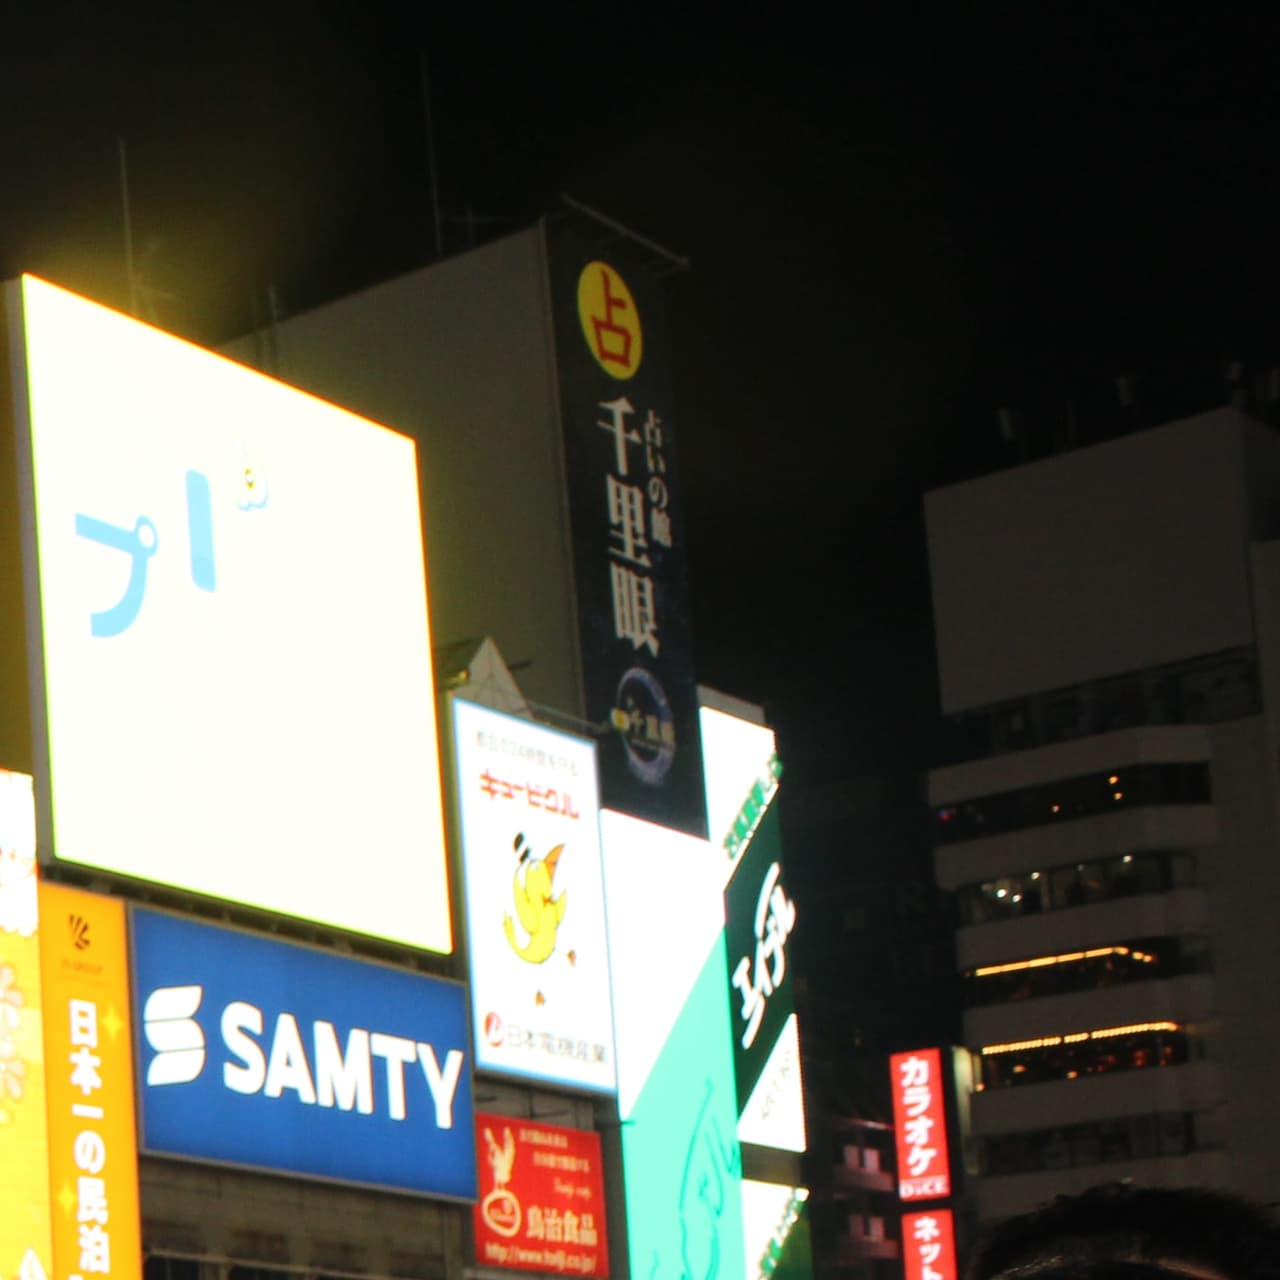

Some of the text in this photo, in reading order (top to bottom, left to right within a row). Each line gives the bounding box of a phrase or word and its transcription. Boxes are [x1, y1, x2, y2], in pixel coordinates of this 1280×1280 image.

[590, 269, 633, 369] 占
[596, 396, 660, 657] 千里眼
[220, 1000, 464, 1129] SAMTY
[899, 1055, 938, 1177] カラオケ
